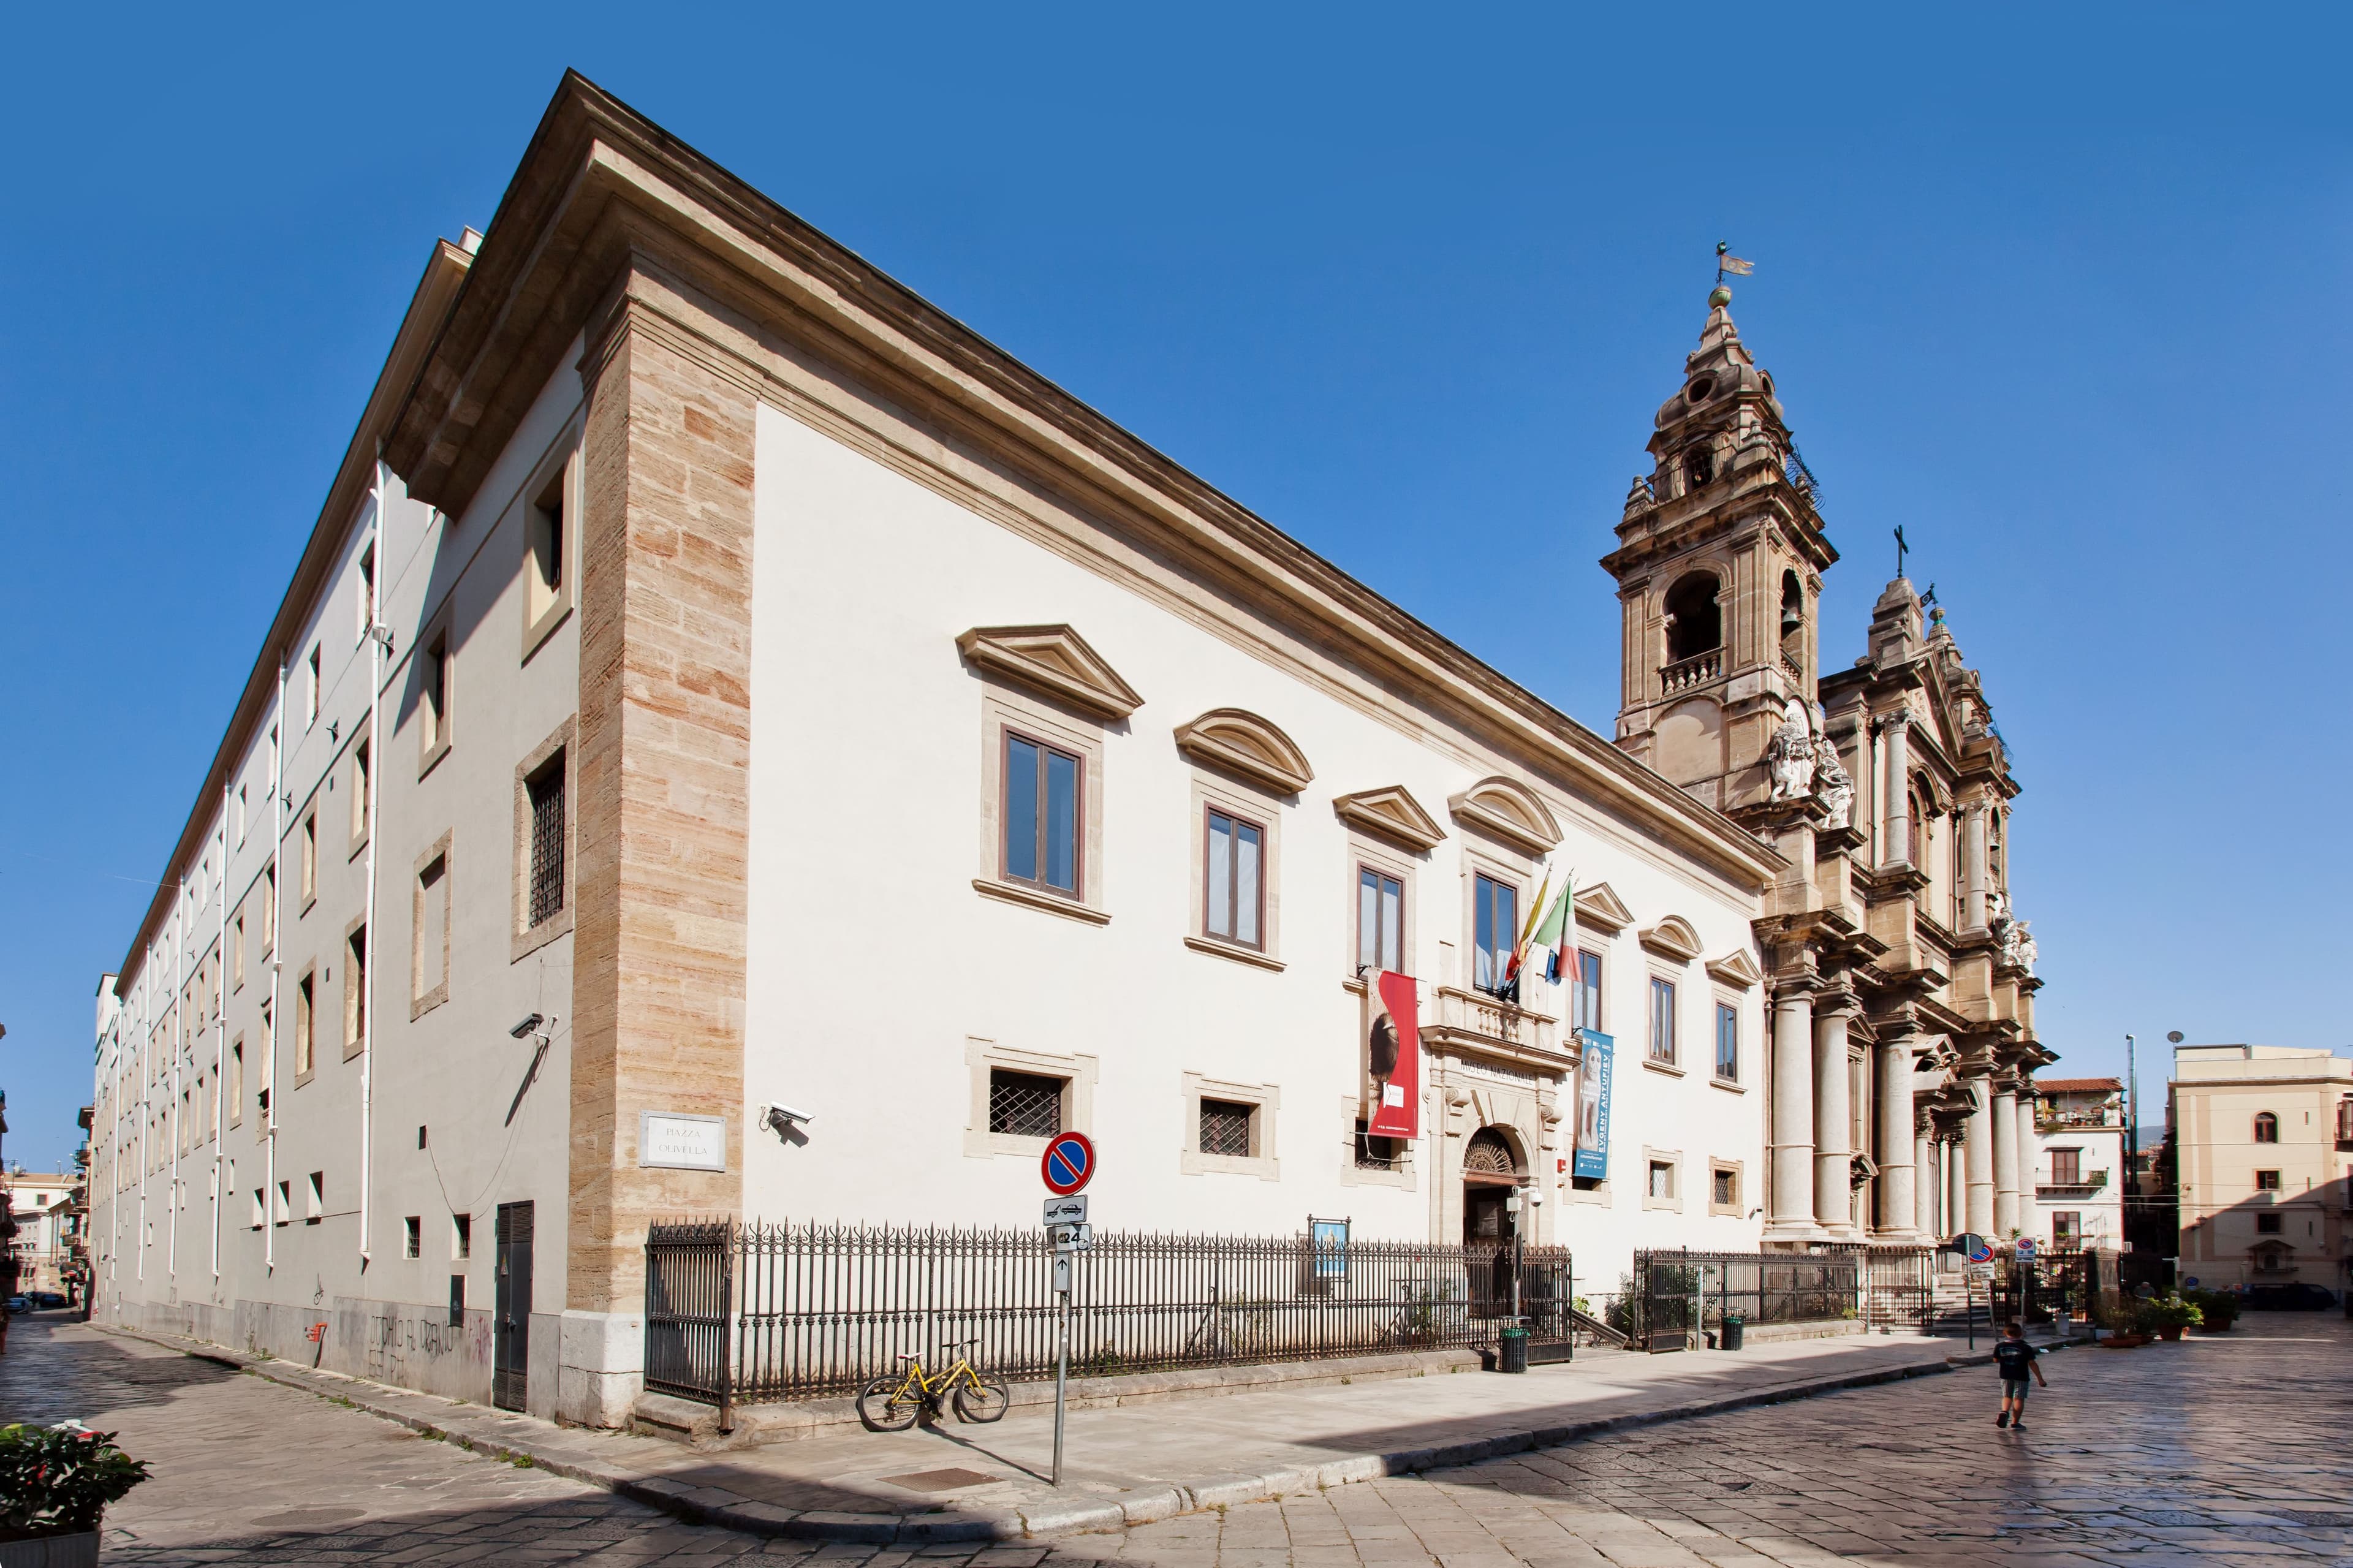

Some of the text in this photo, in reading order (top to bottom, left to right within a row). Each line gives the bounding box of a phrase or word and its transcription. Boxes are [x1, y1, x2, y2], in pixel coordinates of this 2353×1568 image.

[1490, 1066, 1533, 1085] NAZIONALE
[667, 1128, 700, 1138] PIAZZA
[659, 1144, 707, 1155] OLIVELLA
